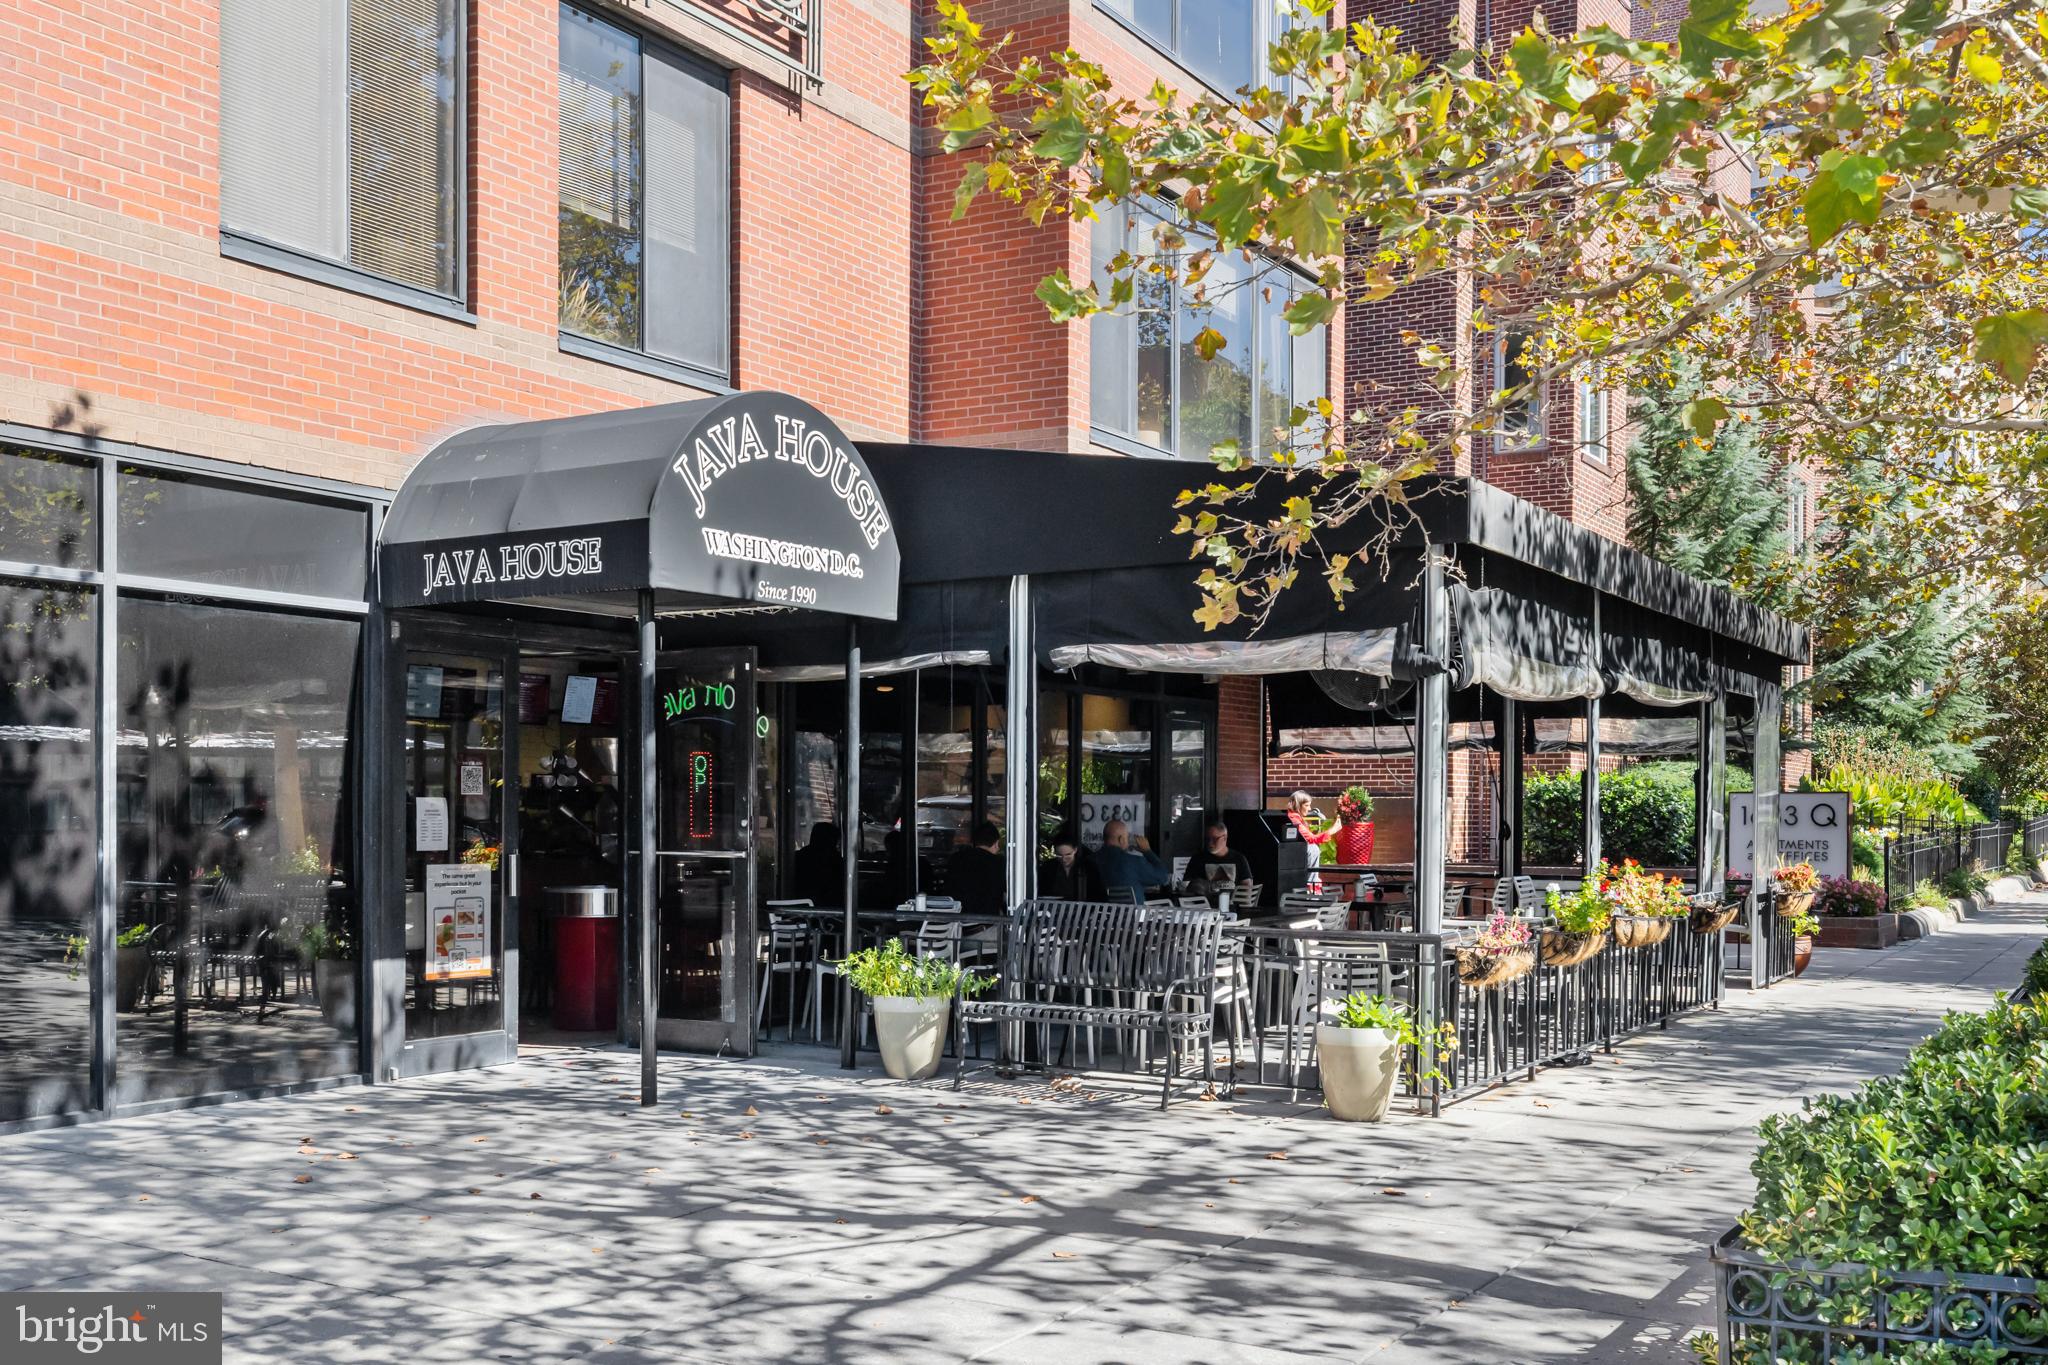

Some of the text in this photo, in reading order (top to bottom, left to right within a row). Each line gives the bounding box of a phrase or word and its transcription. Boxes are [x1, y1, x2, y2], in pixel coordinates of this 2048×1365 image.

[672, 412, 889, 551] JAVA HOUSE
[702, 527, 864, 579] WASHINGTON D.C.
[423, 537, 602, 597] JAVA HOUSE
[757, 580, 817, 605] Since 1990
[1741, 803, 1838, 827] 13 Q
[1747, 839, 1829, 849] ATMENTS
[1779, 851, 1829, 862] FFICES
